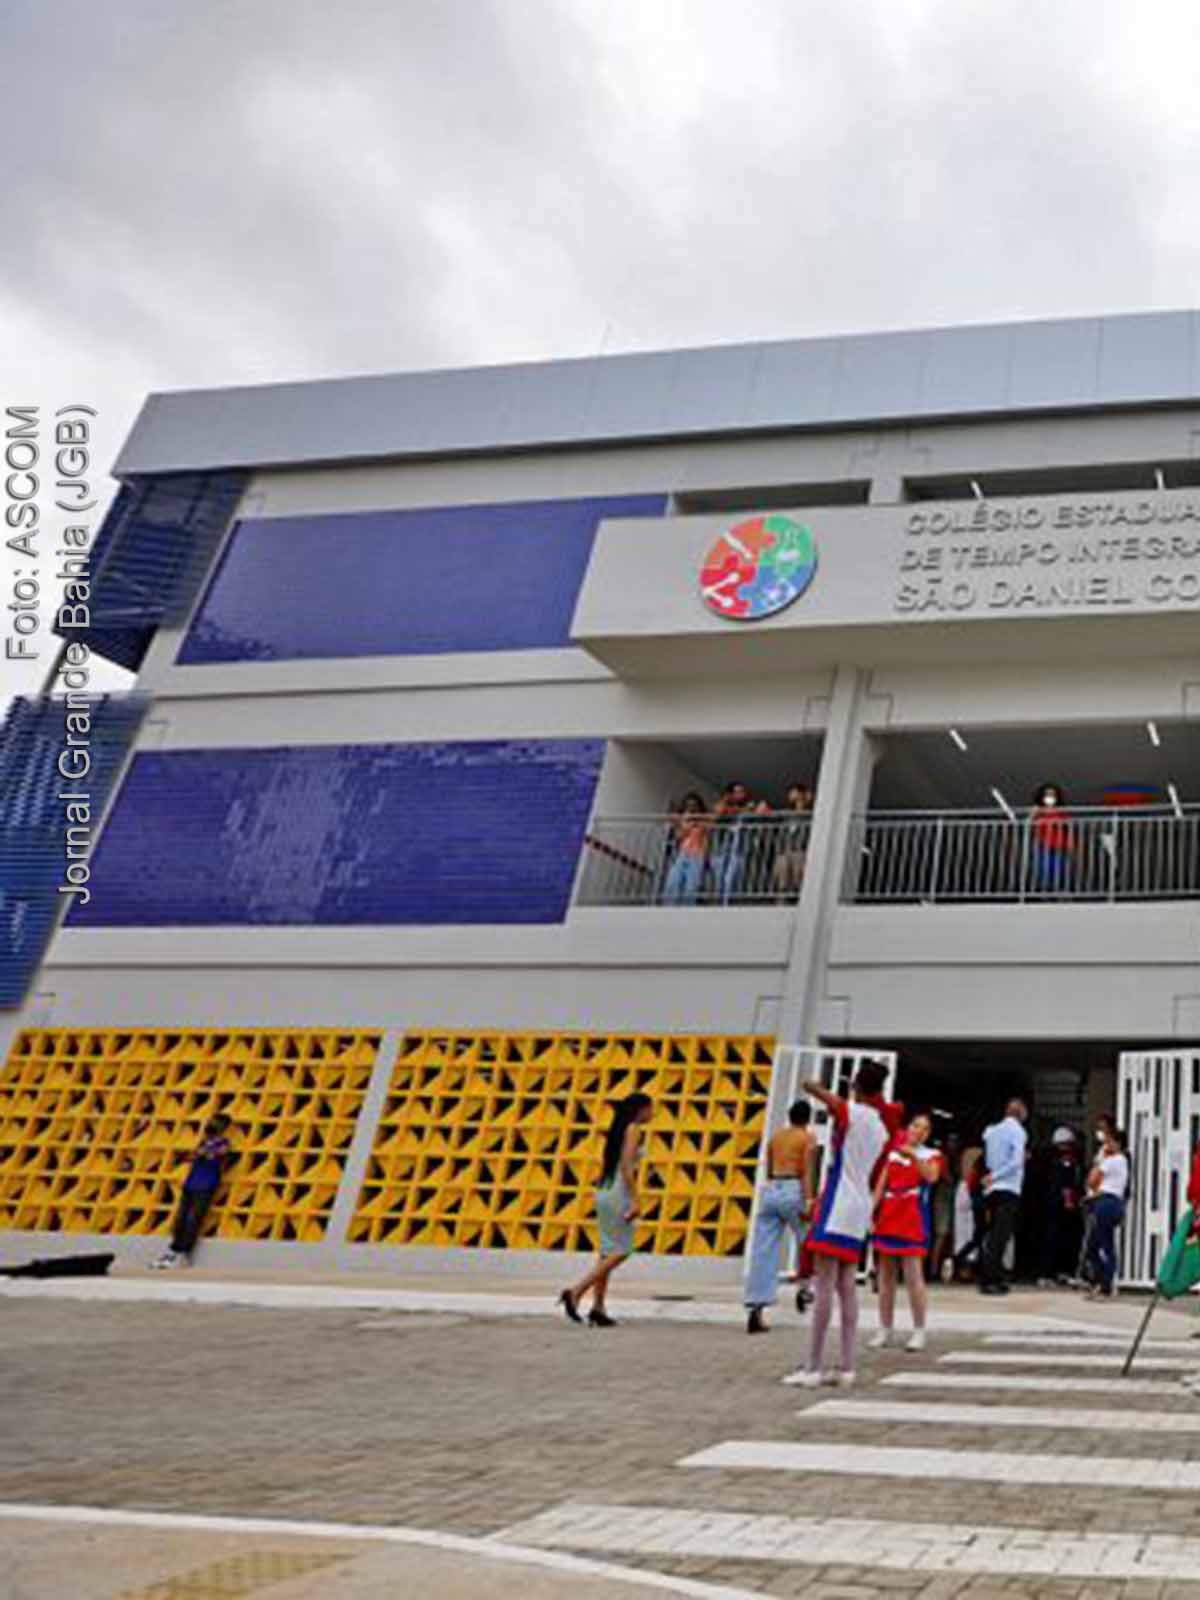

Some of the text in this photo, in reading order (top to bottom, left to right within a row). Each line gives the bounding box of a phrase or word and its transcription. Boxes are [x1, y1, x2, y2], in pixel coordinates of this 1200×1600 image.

[906, 501, 1047, 536] COLÉGIO
[900, 547, 942, 571] DE
[949, 542, 1060, 571] TEMPO
[894, 577, 977, 613] SÃO
[987, 576, 1134, 609] DANIEL
